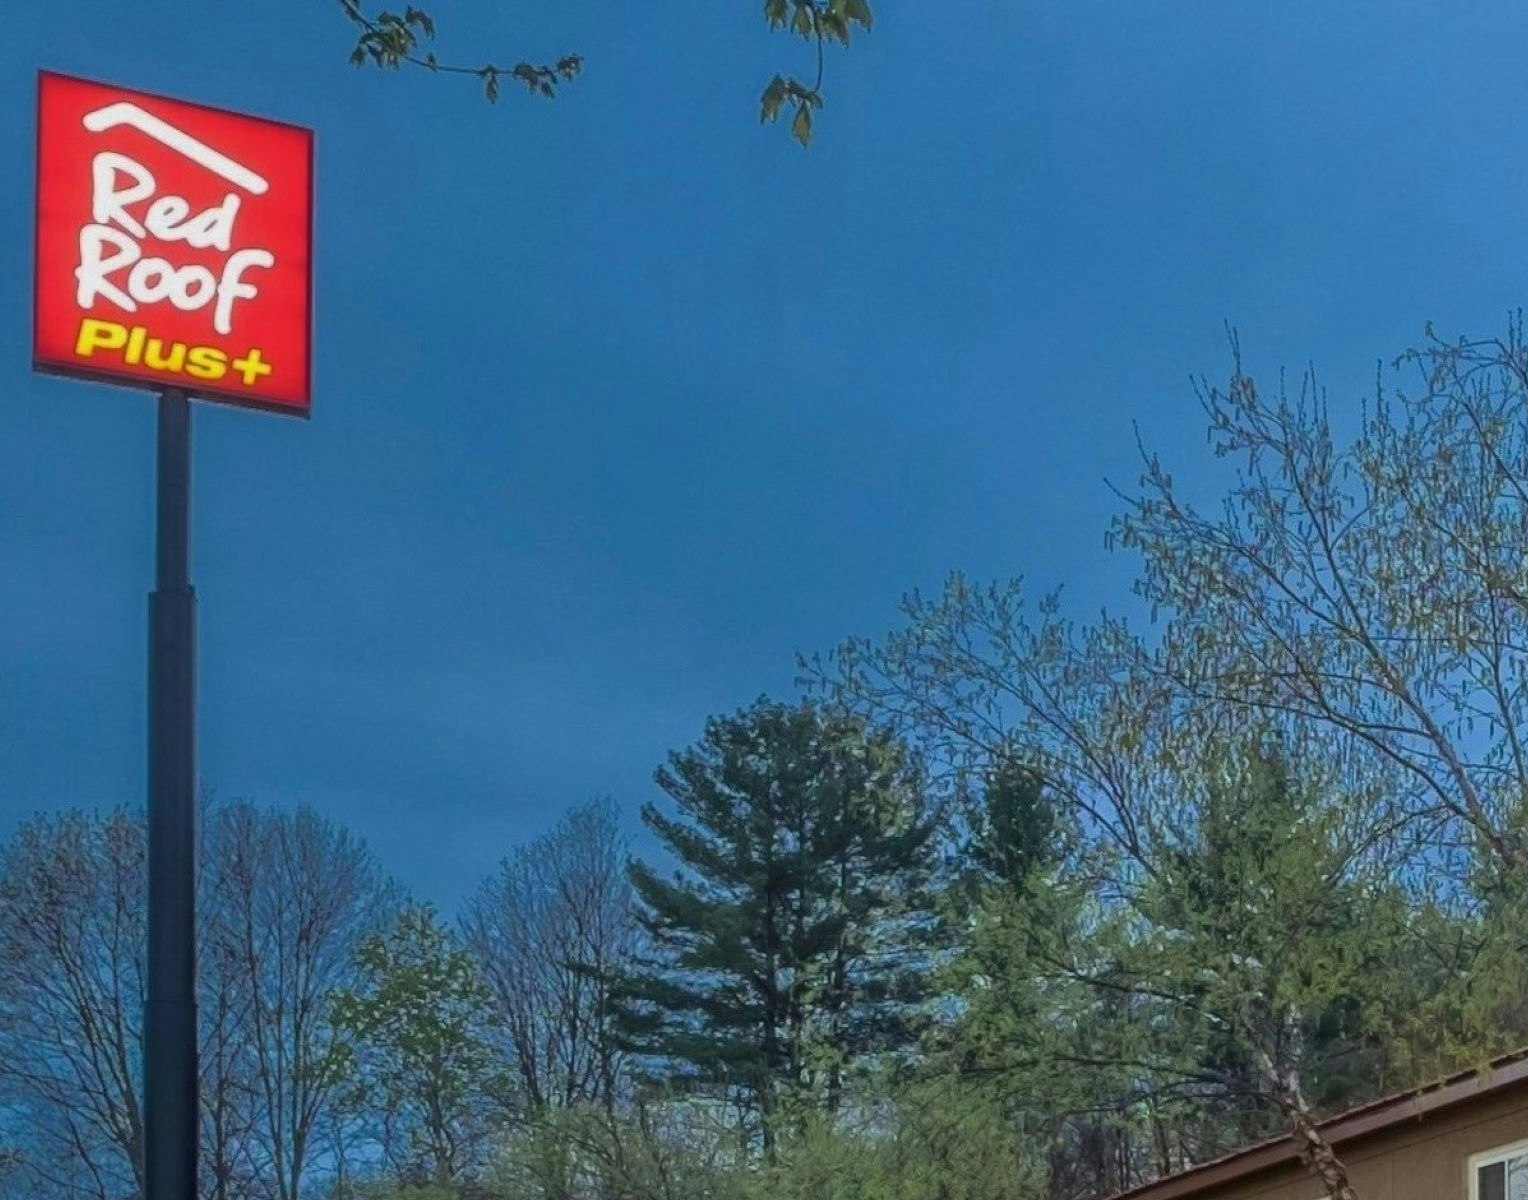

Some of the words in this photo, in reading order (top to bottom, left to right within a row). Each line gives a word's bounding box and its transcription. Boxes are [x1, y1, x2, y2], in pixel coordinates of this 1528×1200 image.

[91, 151, 242, 252] Red
[75, 223, 275, 335] Roof
[75, 318, 272, 385] Plus+
